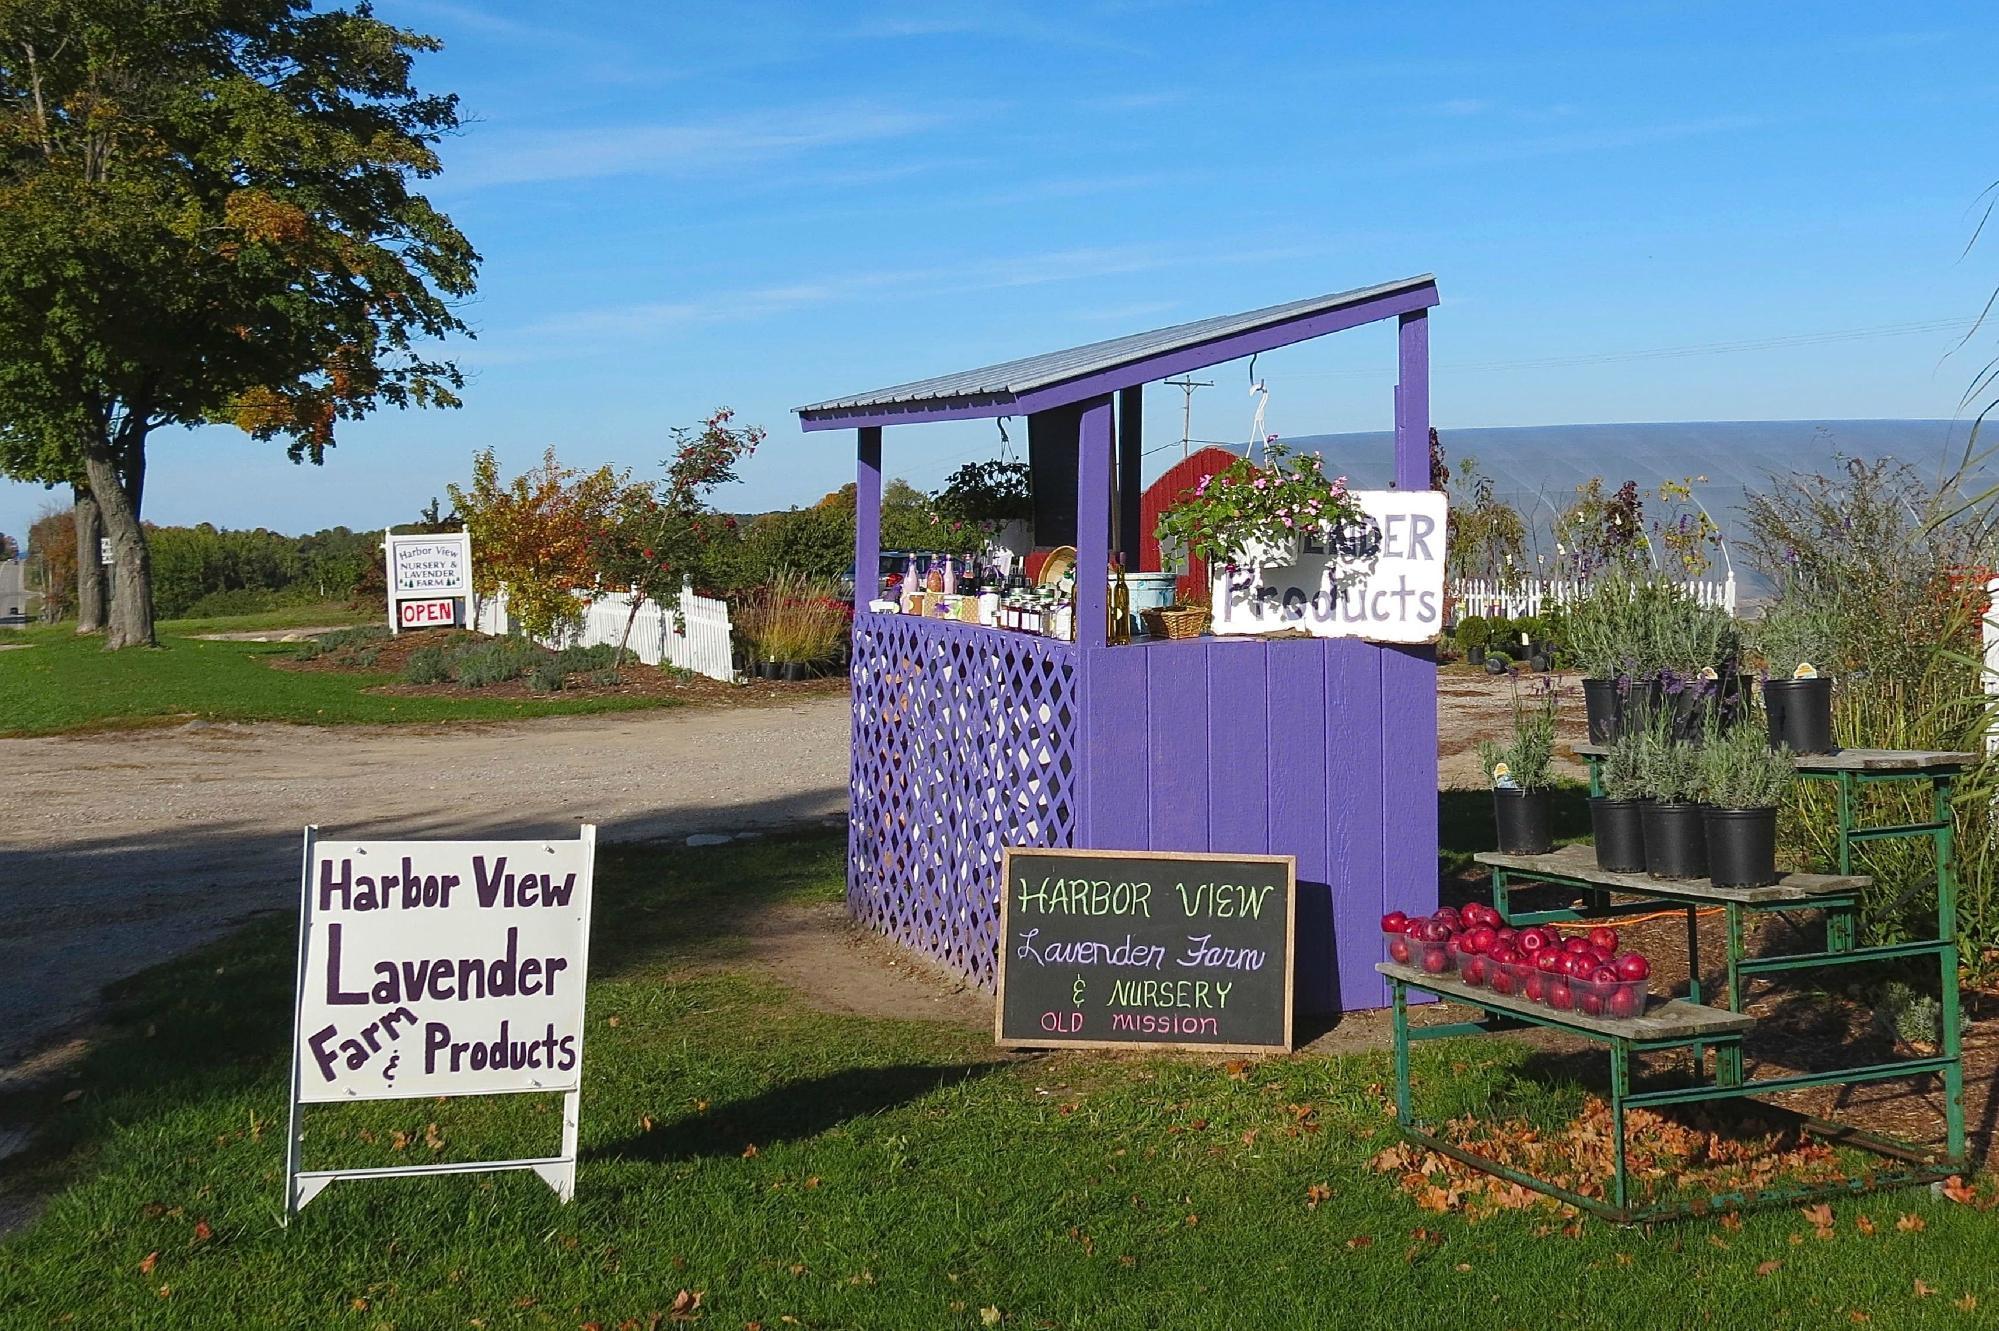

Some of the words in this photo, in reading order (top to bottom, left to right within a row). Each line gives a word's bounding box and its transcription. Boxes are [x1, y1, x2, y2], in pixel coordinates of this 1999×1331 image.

[399, 547, 432, 560] Harbor
[436, 546, 458, 558] View
[401, 561, 446, 570] NURSERY
[404, 570, 455, 578] LAVENDER
[416, 579, 444, 587] FARM
[404, 602, 452, 622] OPEN
[1224, 566, 1437, 623] Products
[319, 856, 460, 911] Harbor
[472, 855, 577, 908] View
[1018, 877, 1151, 918] HARBOR
[1175, 882, 1274, 920] VIEW
[326, 923, 567, 1005] Lavender
[1017, 928, 1165, 970] Lavender
[1176, 933, 1266, 970] Farm
[1072, 973, 1086, 1008] &
[1106, 979, 1232, 1008] NURSERY
[1041, 1012, 1083, 1032] OLD
[308, 1007, 418, 1082] Farm
[425, 1020, 576, 1074] Products
